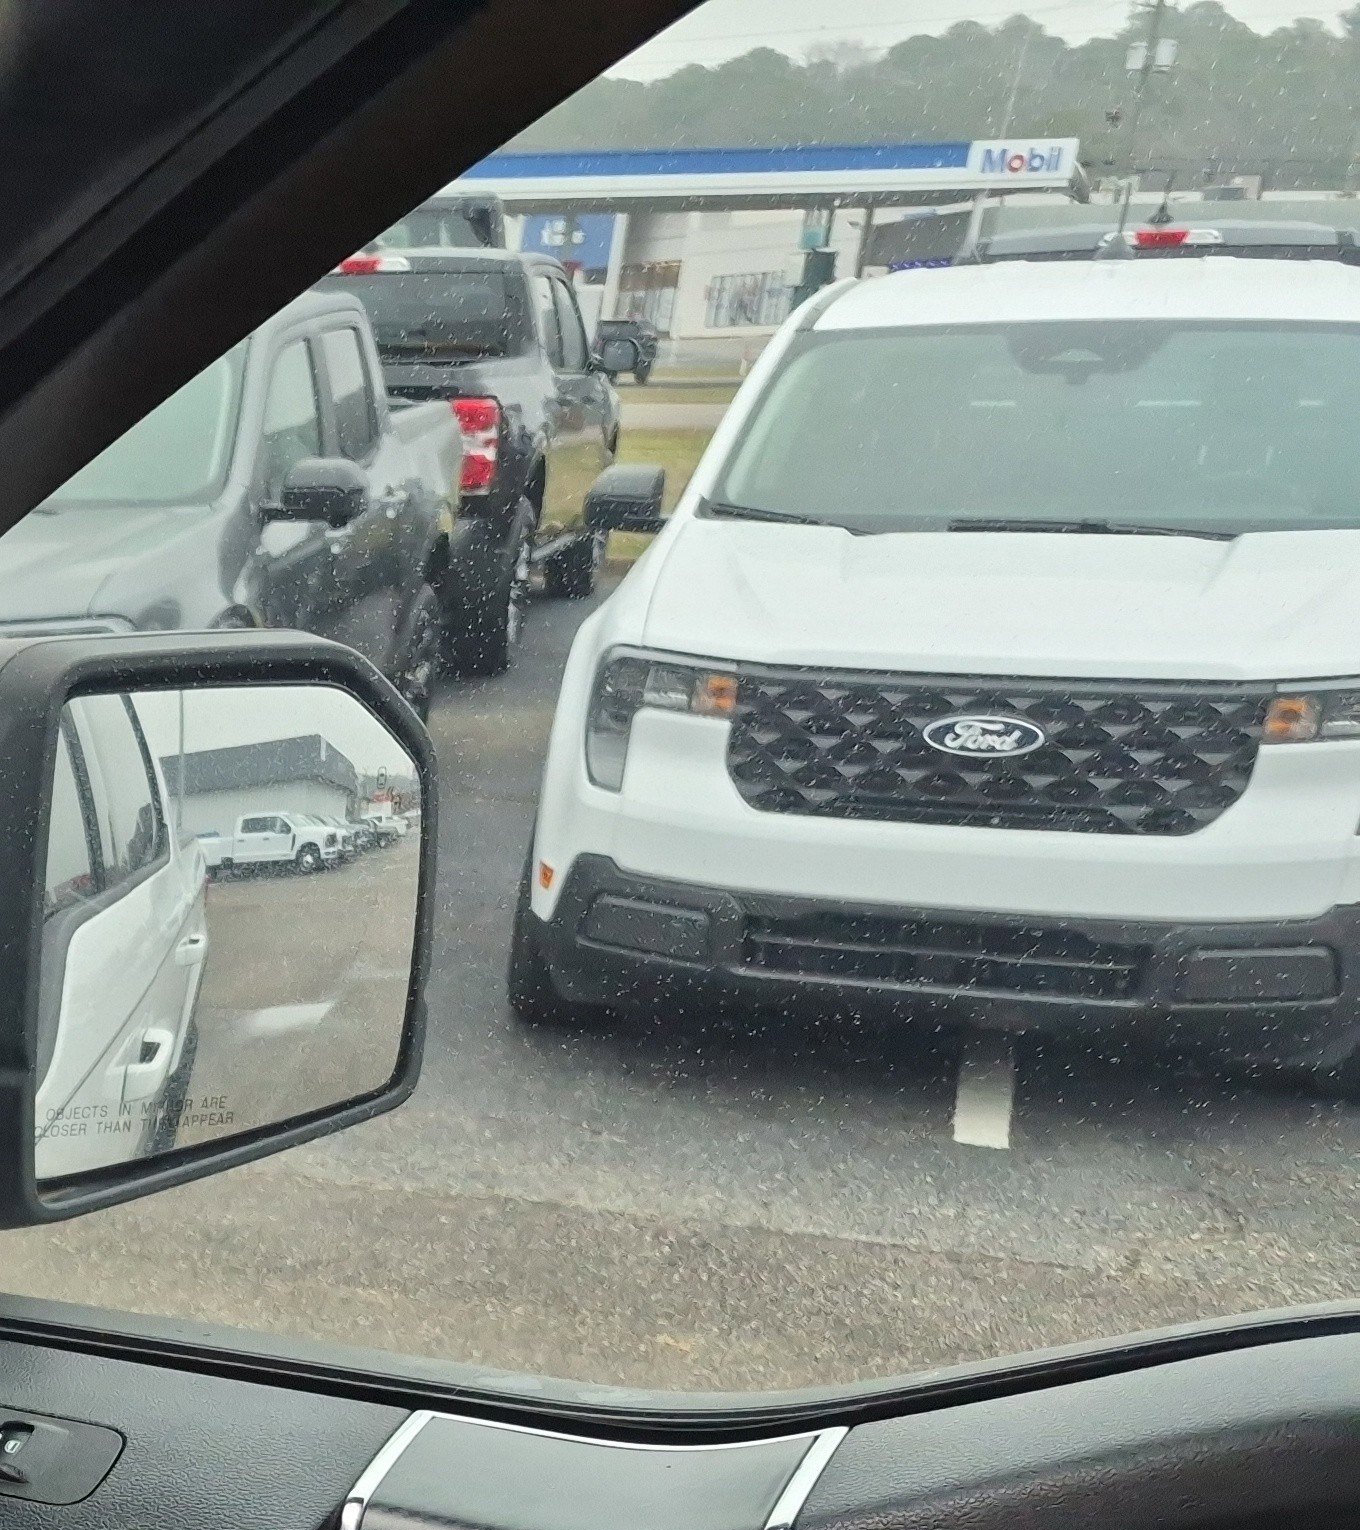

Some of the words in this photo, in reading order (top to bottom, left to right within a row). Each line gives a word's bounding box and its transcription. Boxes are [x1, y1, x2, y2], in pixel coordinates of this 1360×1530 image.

[981, 146, 1063, 173] Mobil
[944, 721, 1022, 750] Ford
[46, 1105, 108, 1121] OBJECTS
[119, 1103, 131, 1116] IN
[201, 1096, 228, 1110] ARE
[35, 1123, 87, 1139] CLOSER
[97, 1120, 131, 1134] THAN
[182, 1111, 234, 1127] APPEAR
